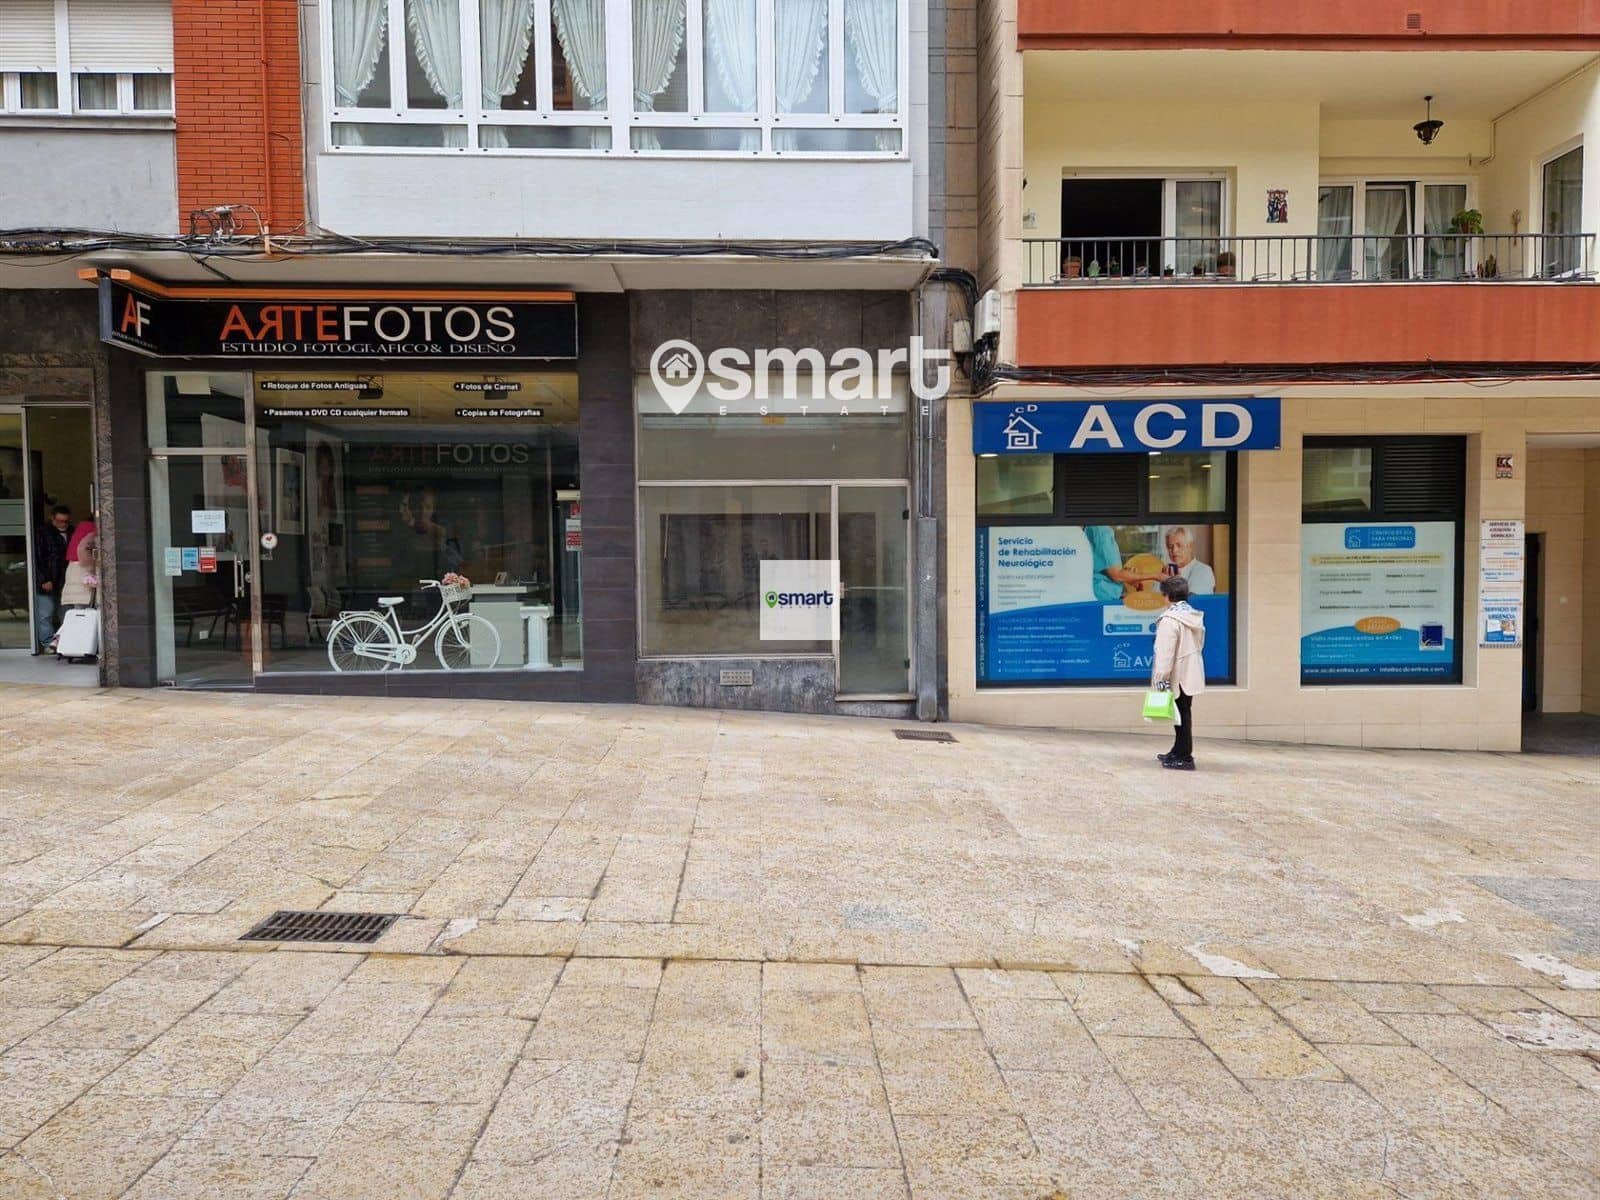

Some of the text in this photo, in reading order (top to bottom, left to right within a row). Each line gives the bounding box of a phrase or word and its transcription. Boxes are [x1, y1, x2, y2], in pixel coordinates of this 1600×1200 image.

[121, 292, 151, 337] AF
[219, 305, 516, 342] ARTEFOTOS
[222, 342, 297, 353] ESTUDIO
[450, 341, 516, 354] DISEÑO
[267, 383, 298, 391] Retoque
[334, 382, 367, 391] Antiguas
[343, 409, 377, 417] cualquier
[462, 409, 487, 417] Copias
[1069, 403, 1253, 449] ACD
[998, 537, 1034, 545] Servicio
[998, 547, 1077, 557] de Rehabilitación
